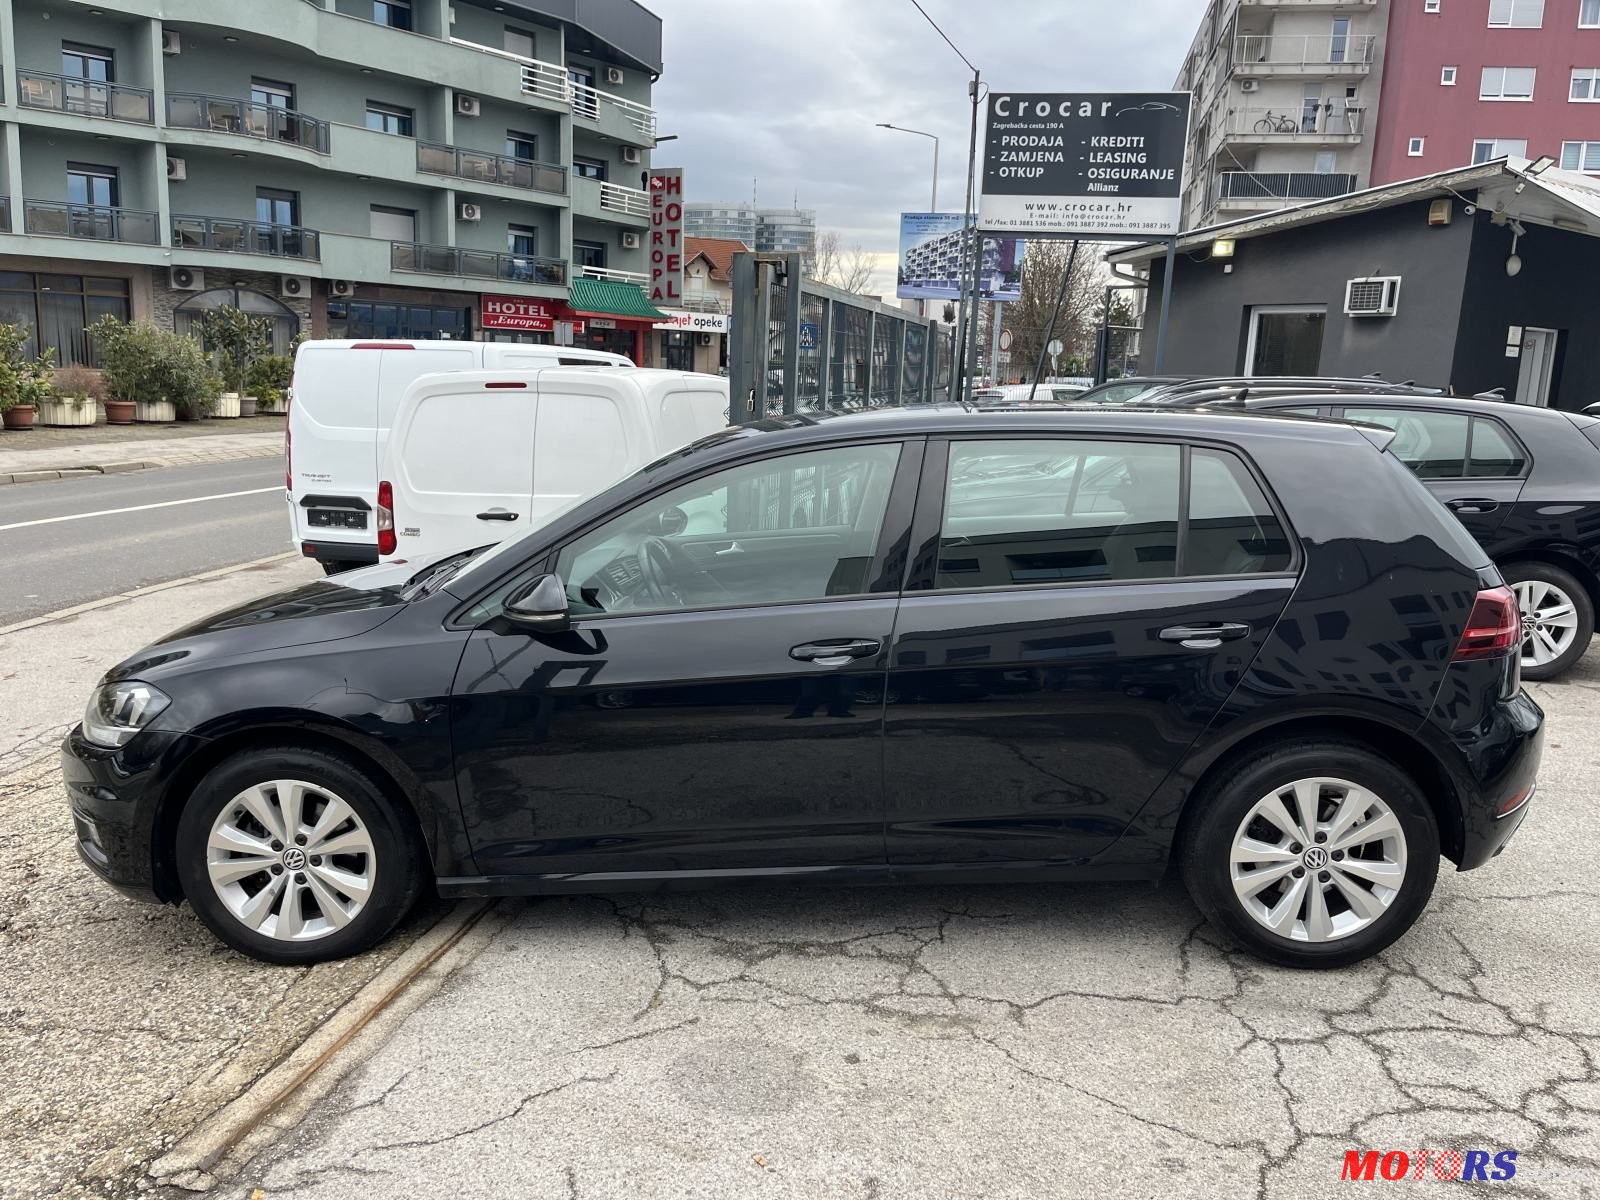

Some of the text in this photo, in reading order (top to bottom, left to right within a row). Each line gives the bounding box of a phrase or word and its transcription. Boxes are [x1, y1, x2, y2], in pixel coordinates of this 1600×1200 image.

[995, 96, 1112, 117] Crocar
[1001, 135, 1064, 147] PRODAJA
[1091, 136, 1145, 147] KREDITI
[999, 151, 1064, 162] ZAMJENA
[1089, 152, 1147, 163] LEASING
[999, 166, 1044, 178] OTKUP
[1087, 168, 1175, 180] OSIGURANJE
[1087, 182, 1119, 192] Allianz
[1025, 202, 1132, 212] www.crocar.hr
[665, 176, 682, 299] HOTEL
[652, 194, 664, 300] EUROPA
[487, 301, 549, 317] HOTEL
[694, 315, 723, 329] opeke
